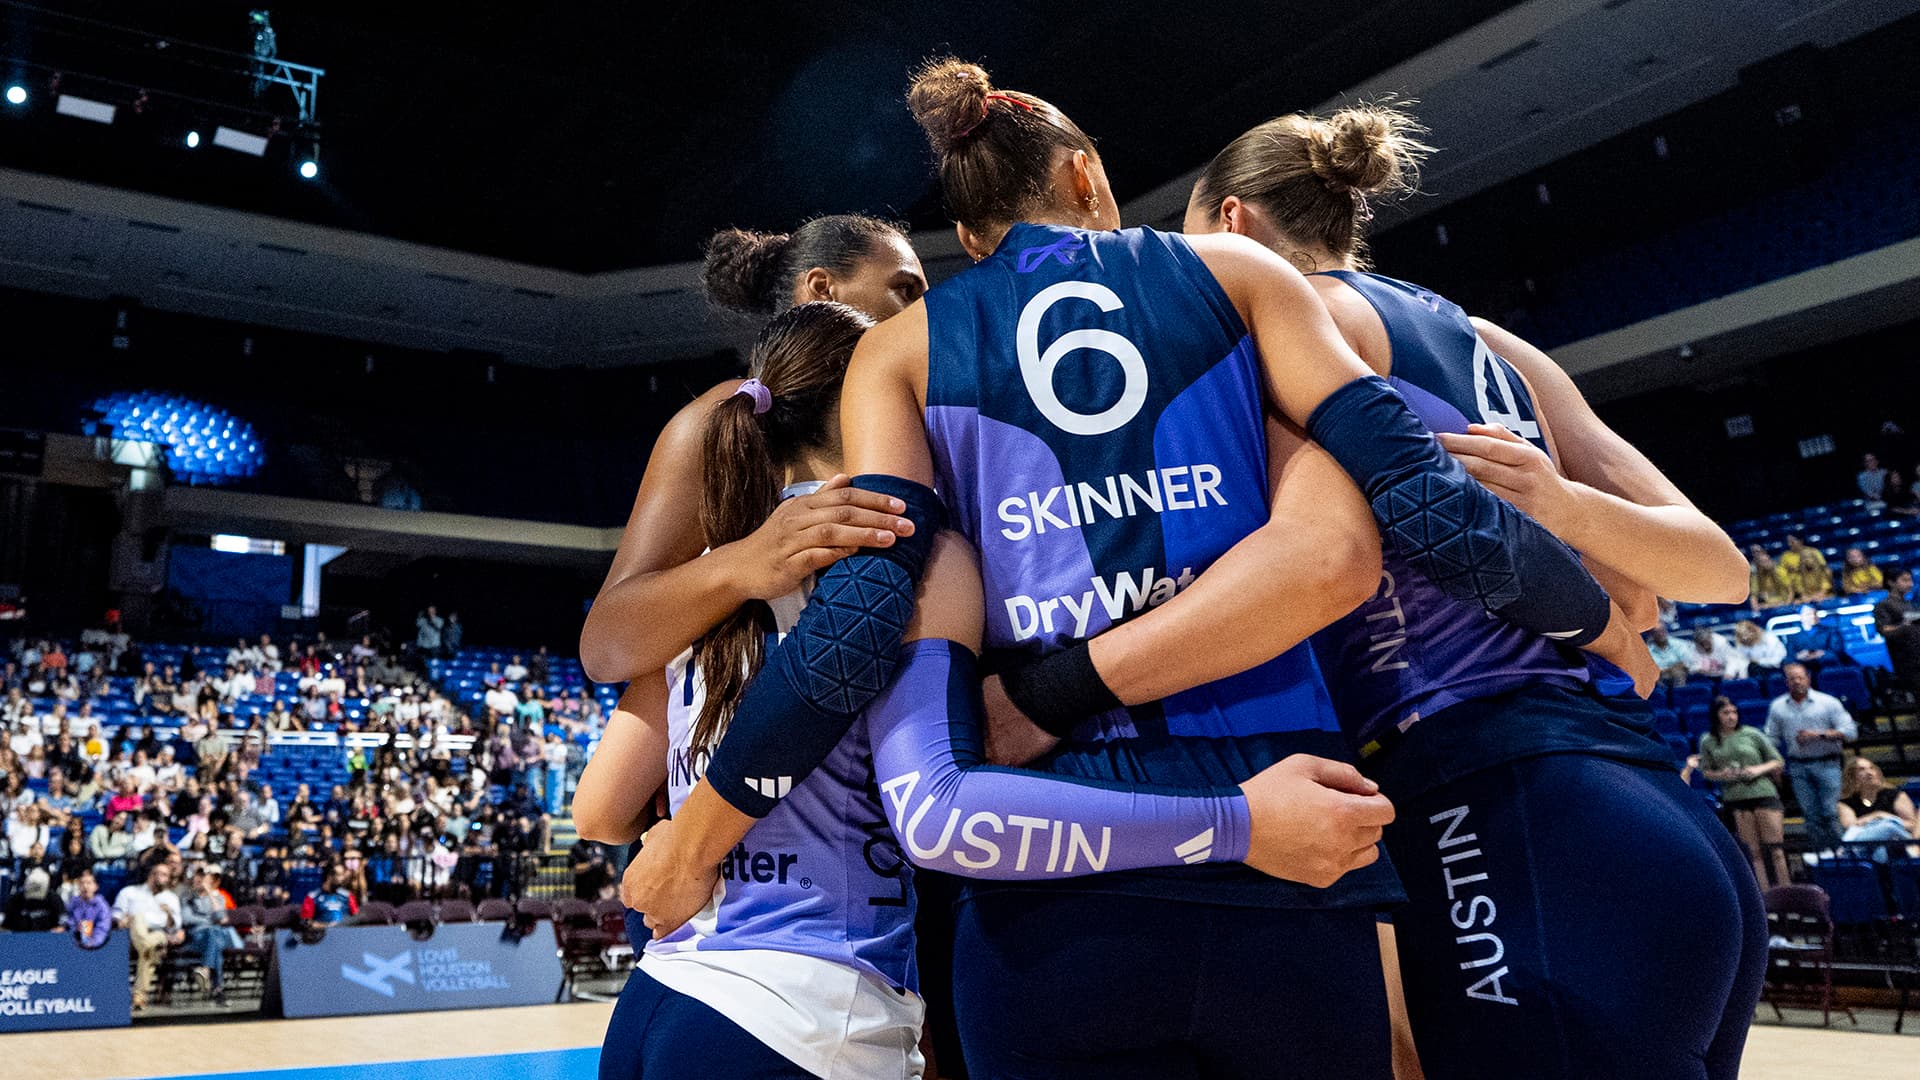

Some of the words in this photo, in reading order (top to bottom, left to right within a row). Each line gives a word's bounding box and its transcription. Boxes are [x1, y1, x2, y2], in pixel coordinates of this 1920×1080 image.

[1016, 280, 1149, 436] 6
[1473, 333, 1541, 439] 4
[998, 464, 1229, 541] SKINNER
[1004, 567, 1196, 642] DryWat
[881, 770, 1112, 873] AUSTIN
[1429, 804, 1519, 1007] AUSTIN
[0, 967, 58, 986] EAGUE
[0, 997, 97, 1016] OLLEYBALL
[419, 960, 491, 978] HOUSTON
[422, 975, 512, 993] VOLLEYBALL
